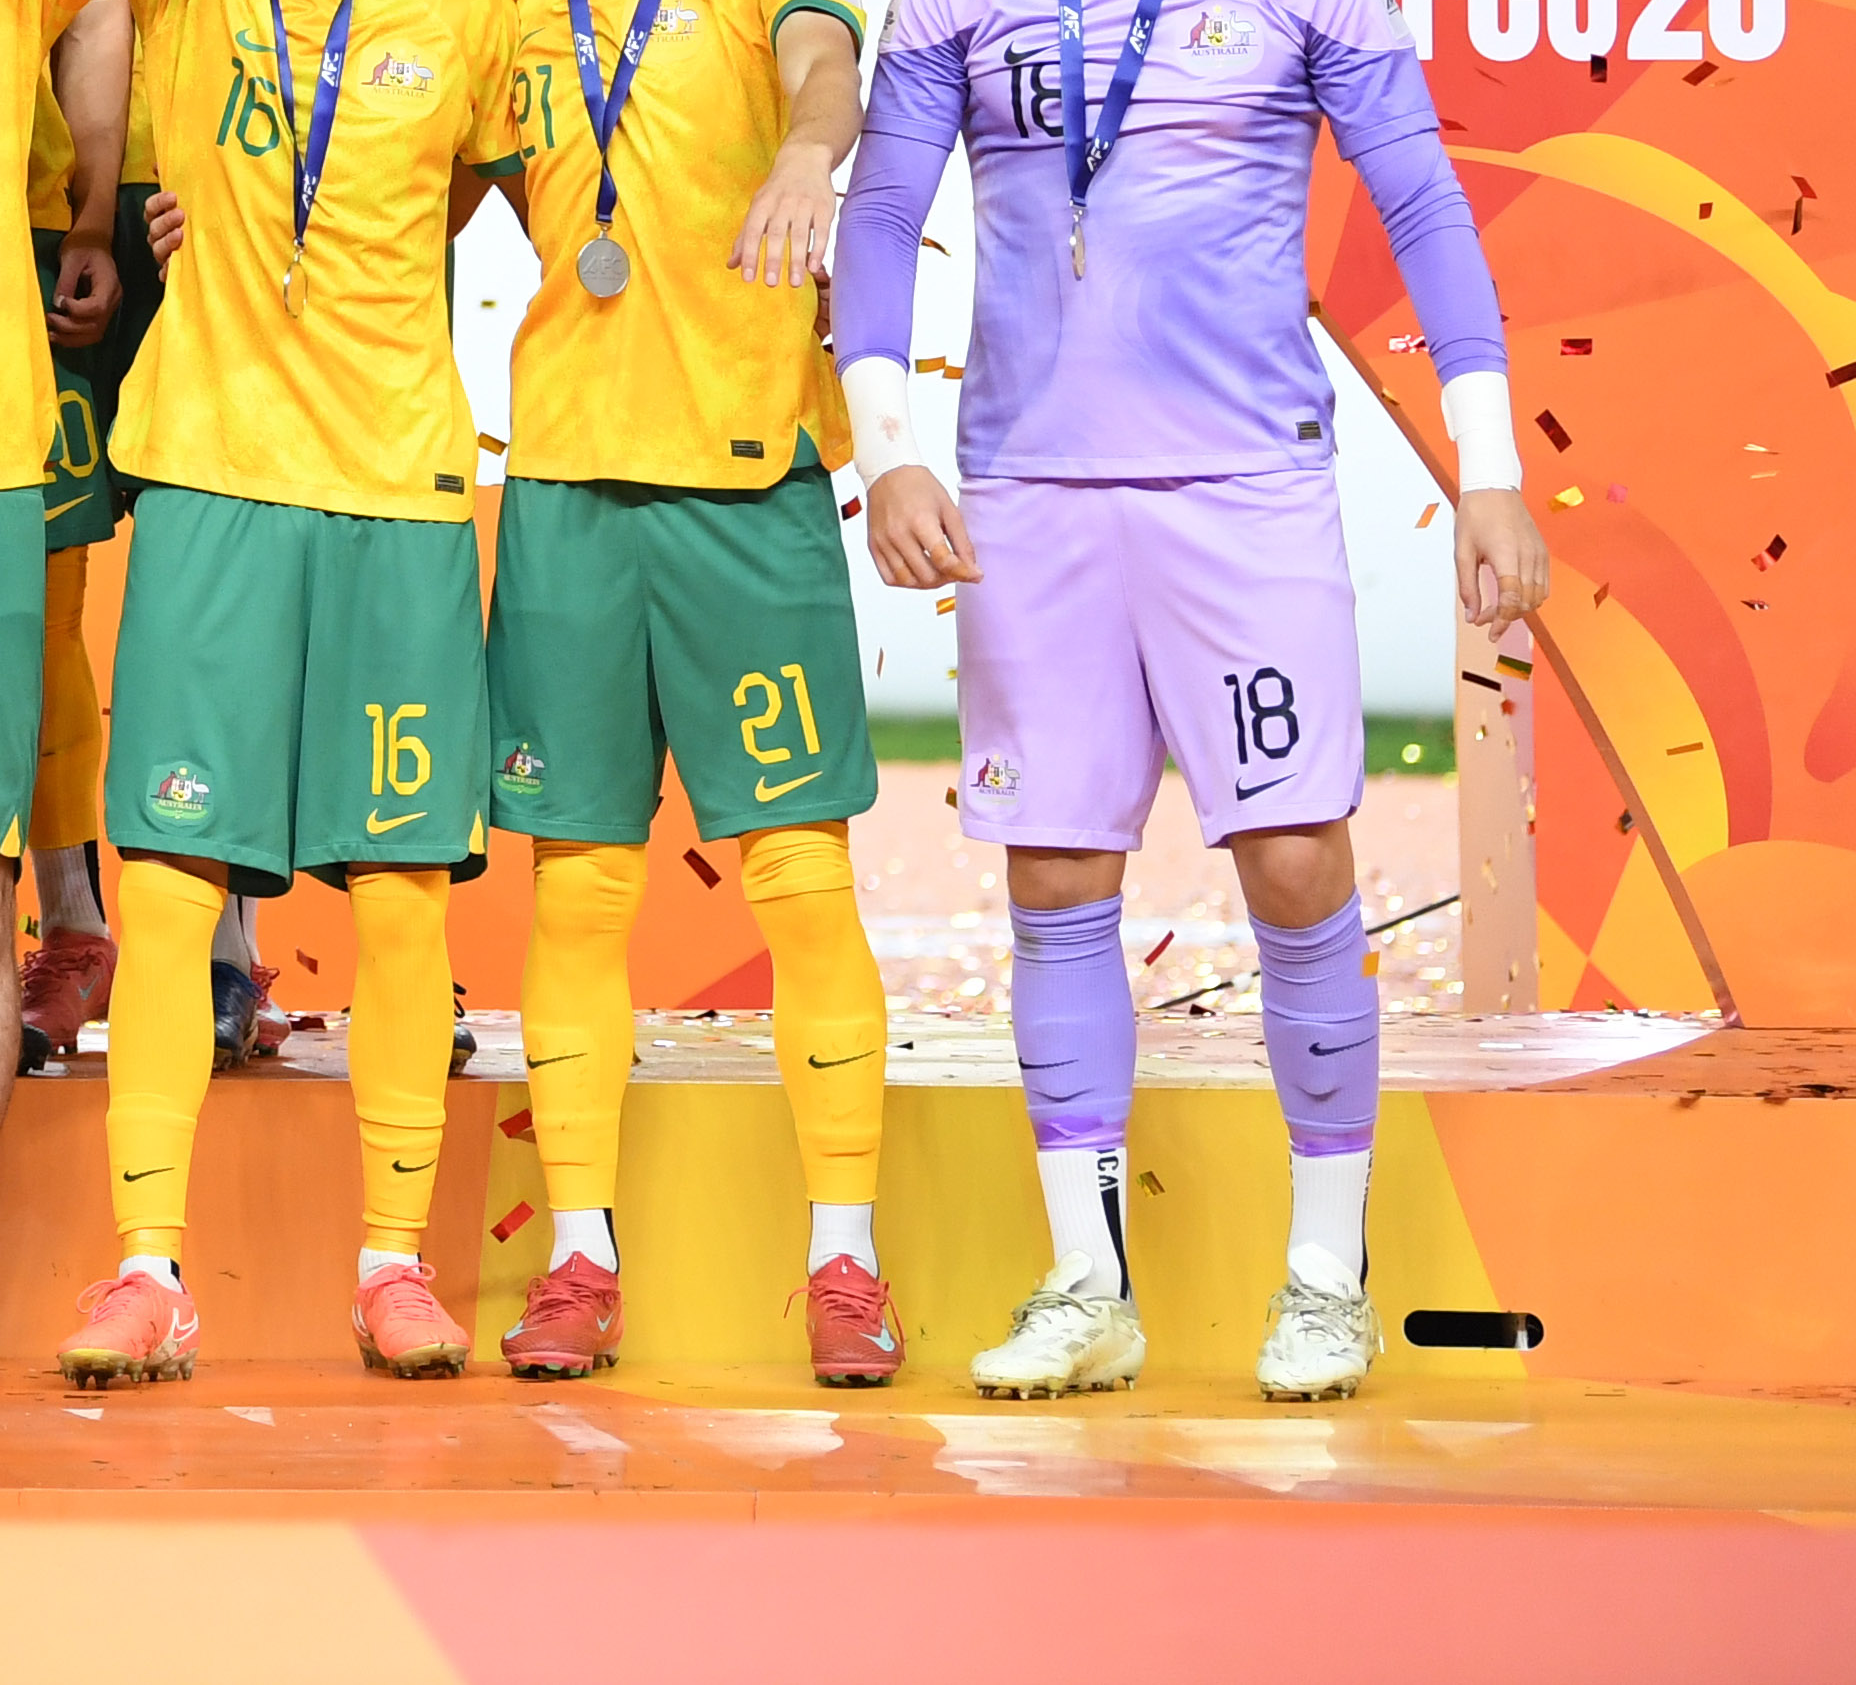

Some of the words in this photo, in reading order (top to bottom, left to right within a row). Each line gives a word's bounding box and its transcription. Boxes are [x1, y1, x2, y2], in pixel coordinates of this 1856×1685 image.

[1063, 5, 1081, 41] AFC
[1129, 16, 1151, 55] AFC
[576, 32, 596, 66] AFC
[623, 29, 645, 64] AFC
[1191, 46, 1249, 57] AUSTRALIA
[321, 49, 340, 87] AFC
[215, 56, 281, 158] 16
[372, 86, 427, 100] AUSTRALIA
[1086, 137, 1109, 173] AFC
[301, 171, 317, 211] AFC
[43, 390, 101, 483] 0
[732, 664, 820, 764] 21
[1223, 667, 1300, 765] 18
[365, 703, 432, 796] 16
